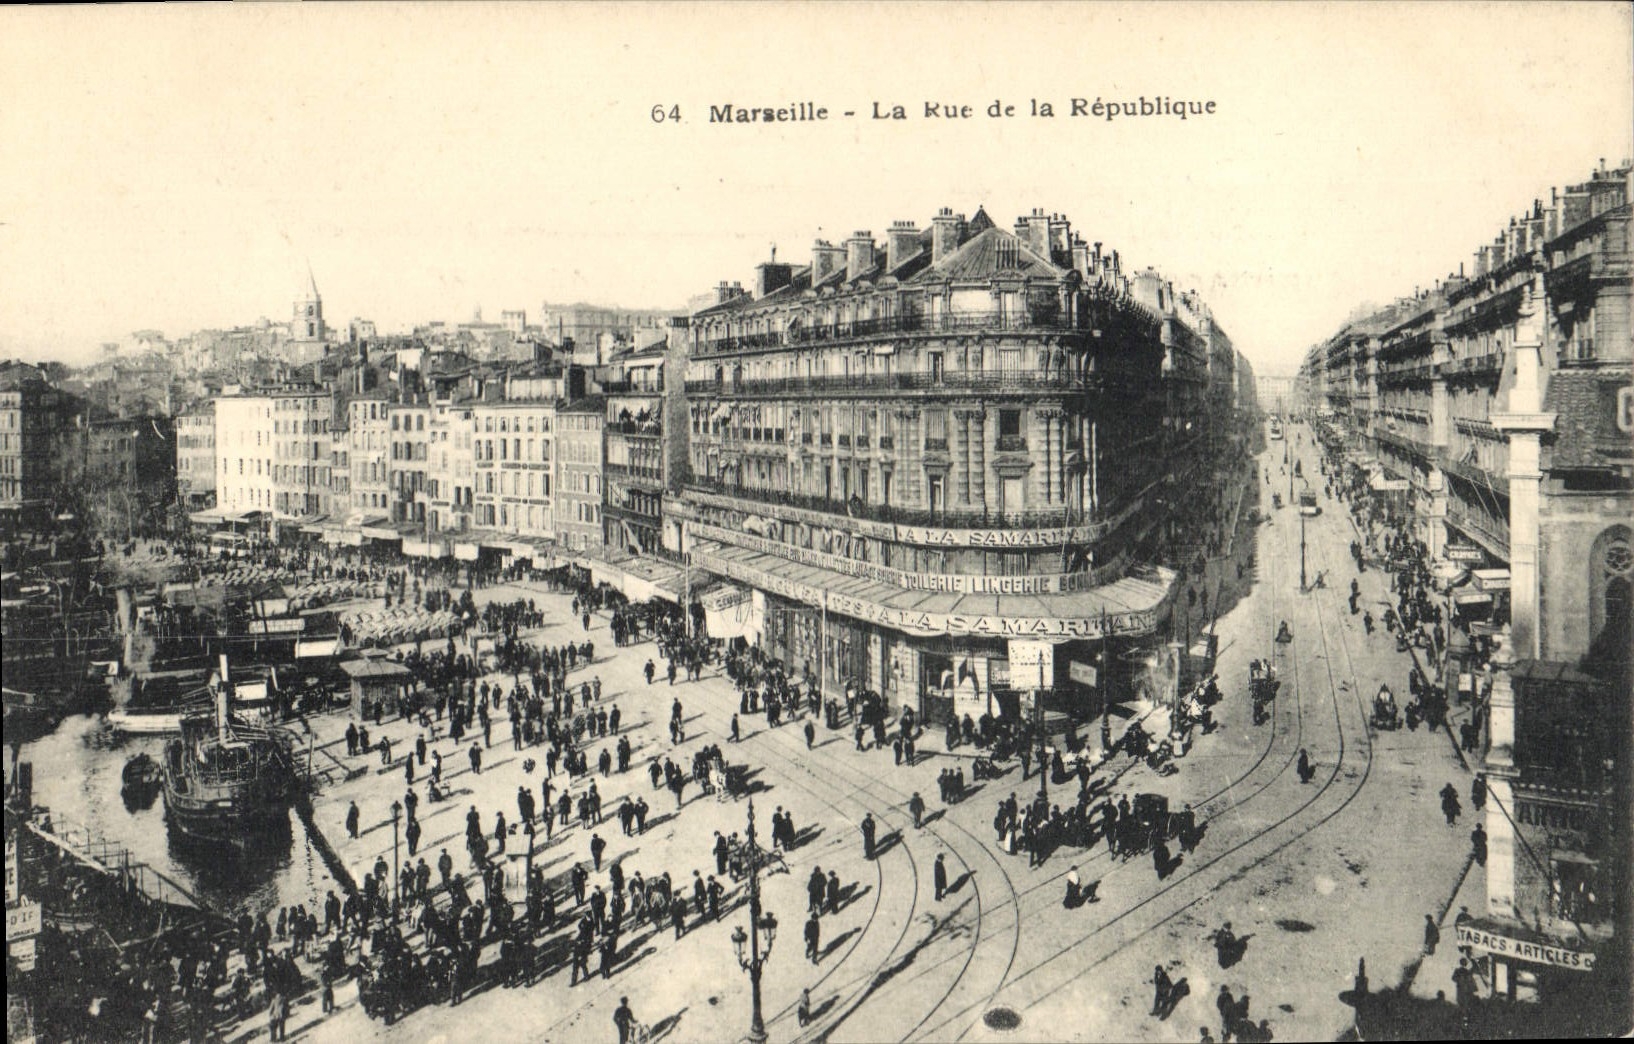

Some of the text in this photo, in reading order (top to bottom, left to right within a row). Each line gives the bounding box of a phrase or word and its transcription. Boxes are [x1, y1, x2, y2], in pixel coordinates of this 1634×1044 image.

[904, 574, 962, 592] TOILERIE
[971, 576, 1051, 593] LINGERIE
[1458, 929, 1507, 952] TABACS
[1515, 941, 1580, 966] ARTICLES
